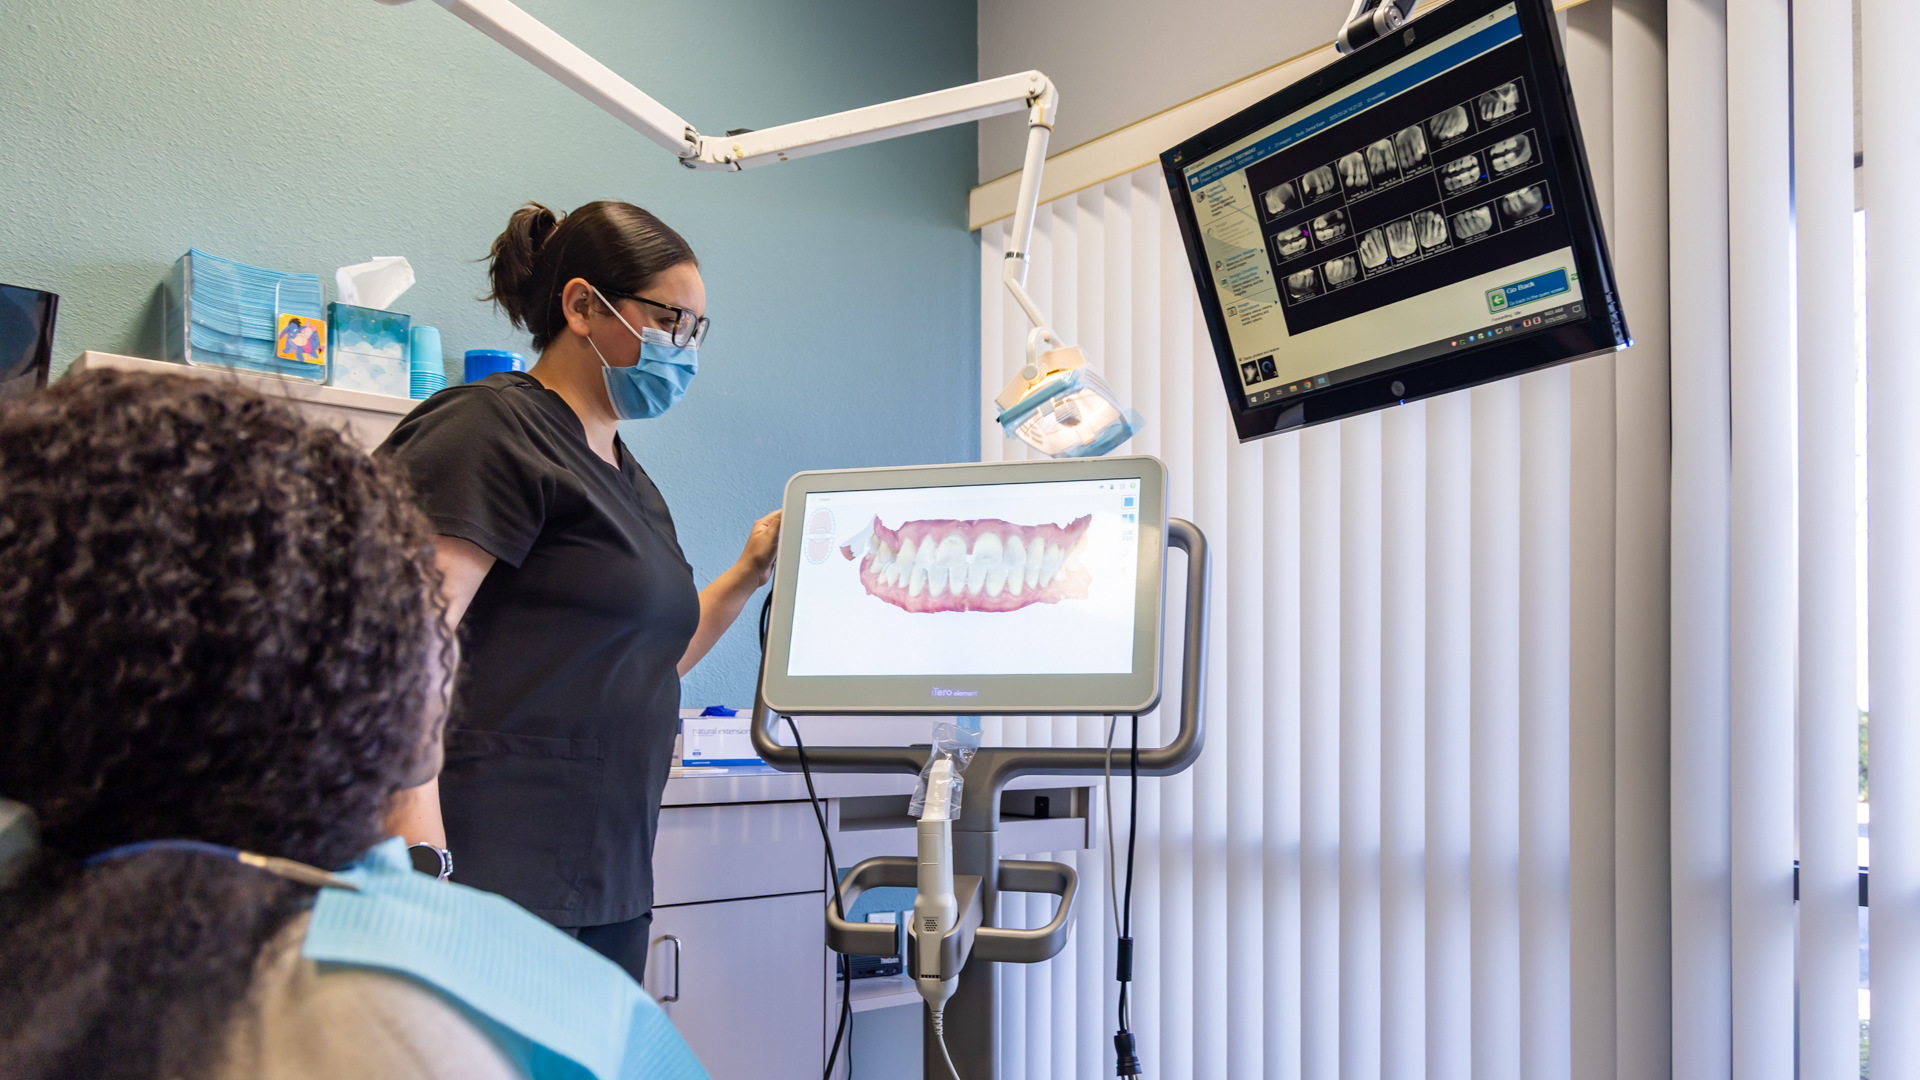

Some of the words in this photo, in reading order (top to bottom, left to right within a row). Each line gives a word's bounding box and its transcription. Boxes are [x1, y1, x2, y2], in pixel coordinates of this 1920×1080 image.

[1518, 282, 1535, 291] Back
[931, 686, 952, 696] iTero
[692, 727, 717, 735] natural
